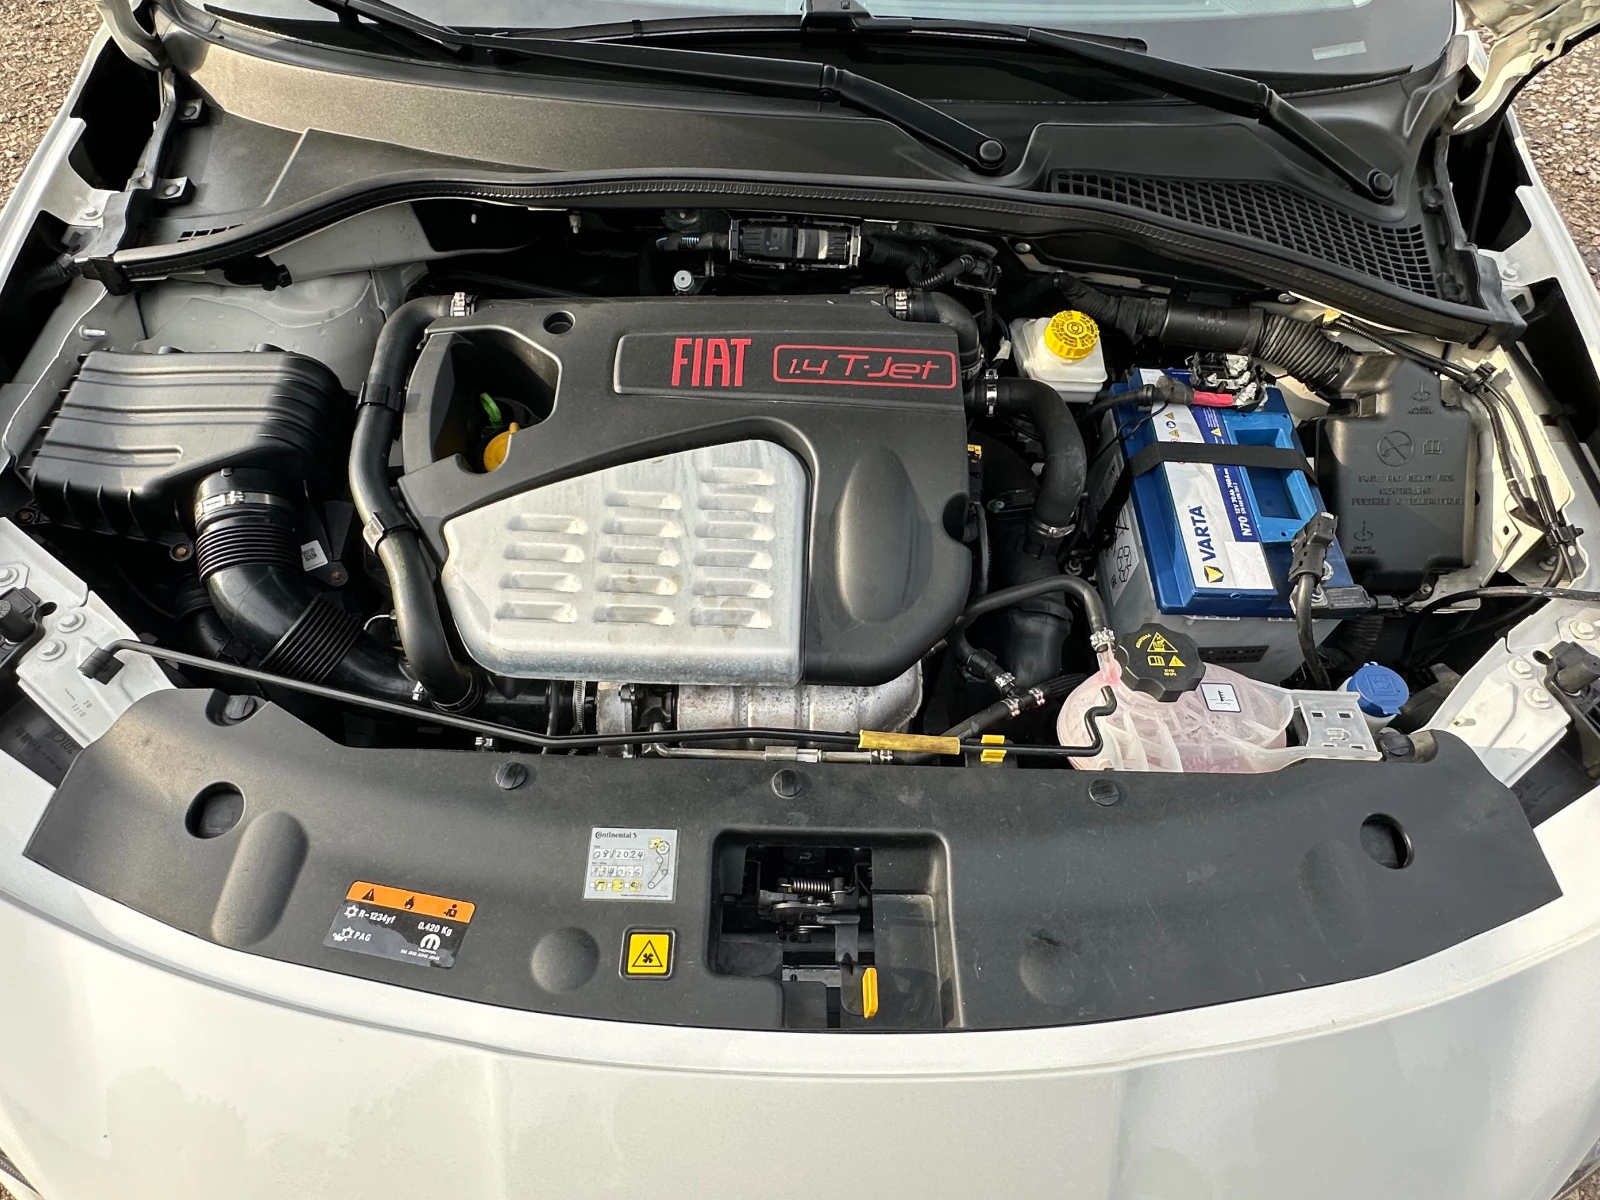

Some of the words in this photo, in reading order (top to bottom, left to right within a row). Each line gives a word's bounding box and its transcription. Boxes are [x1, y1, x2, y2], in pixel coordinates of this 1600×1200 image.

[671, 338, 752, 387] FIAT
[789, 358, 828, 375] 1.4
[1188, 506, 1217, 562] VARTA
[1237, 516, 1253, 537] N70
[595, 831, 632, 839] Continental
[357, 910, 397, 924] R-1234yf
[353, 931, 372, 942] PAG
[417, 921, 441, 933] 0.420
[440, 925, 453, 937] Kg
